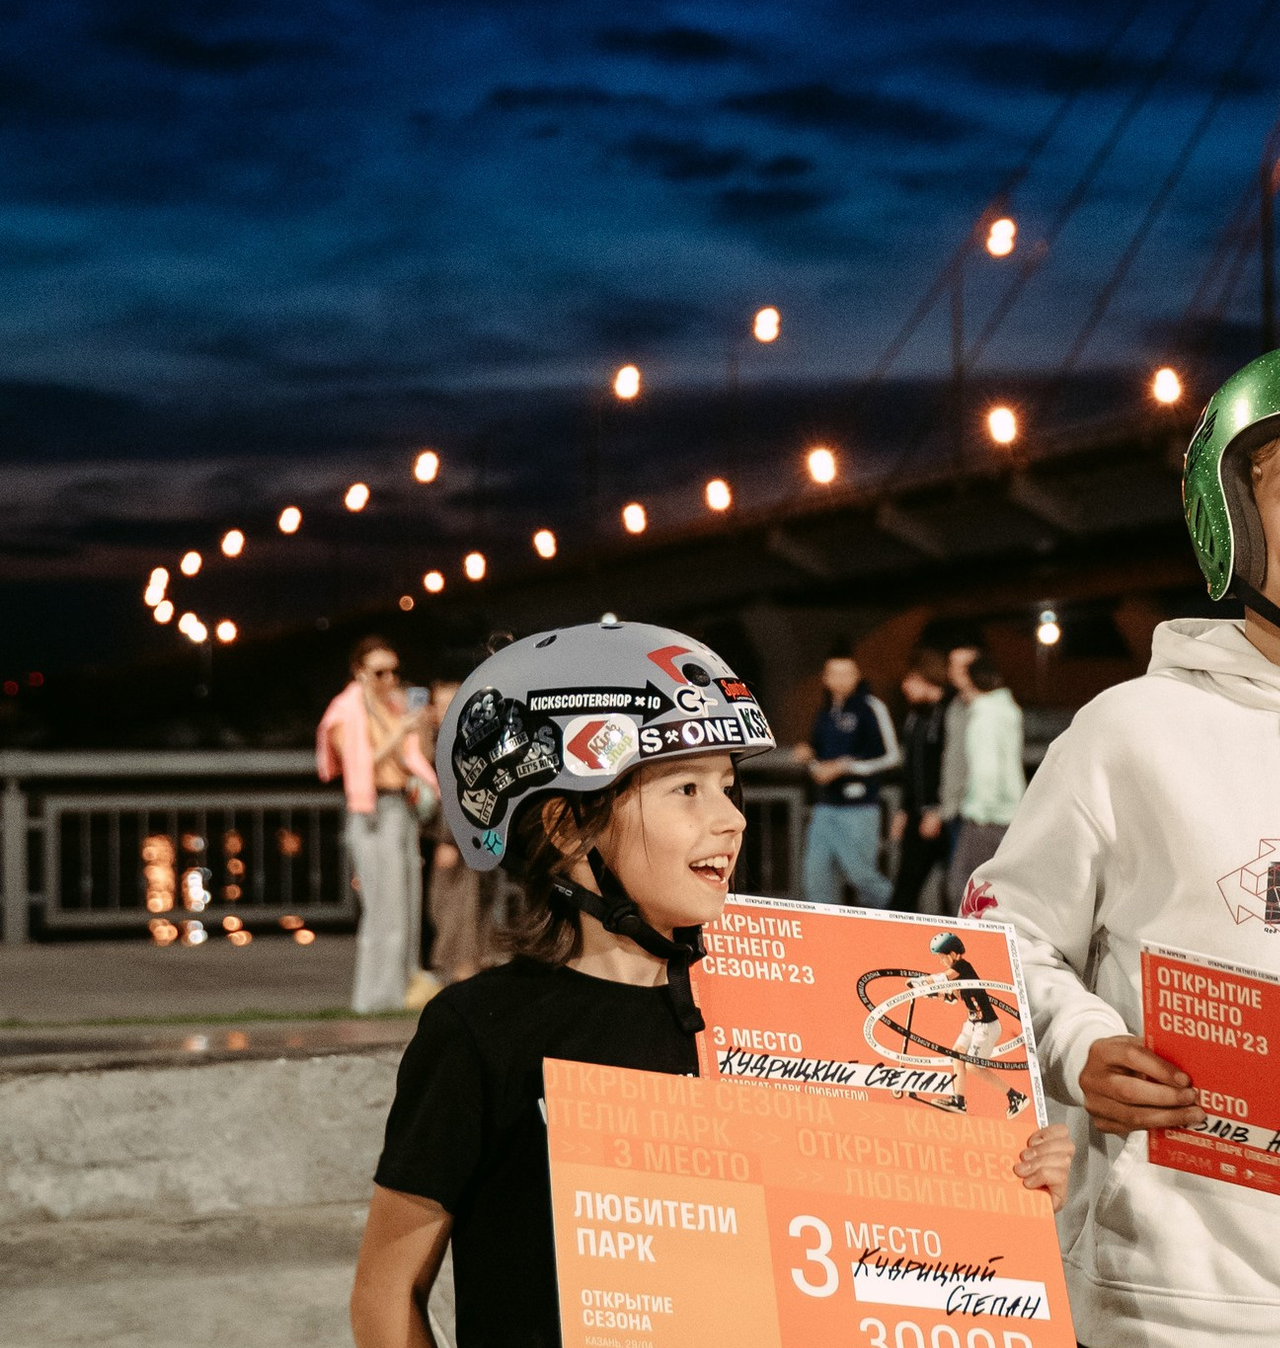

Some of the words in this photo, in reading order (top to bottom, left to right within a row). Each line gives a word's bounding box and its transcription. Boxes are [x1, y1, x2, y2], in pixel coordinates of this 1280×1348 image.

[530, 694, 632, 712] KICKSCOOTERSHOP
[681, 718, 742, 745] ONE
[518, 762, 540, 777] LET'S
[702, 956, 815, 985] СЕЗОНА'23
[1157, 966, 1262, 1010] ОТКРЫТИЕ
[1158, 989, 1243, 1027] ЛЕТНЕГО
[713, 1026, 726, 1046] 3
[732, 1029, 802, 1053] МЕСТО
[1159, 1011, 1269, 1056] СЕЗОНА'23
[715, 1084, 834, 1125] СЕЗОНА
[905, 1110, 1017, 1150] КАЗАНЬ
[1196, 1087, 1249, 1118] ЕСТО
[650, 1109, 734, 1148] ПАРК
[800, 1128, 956, 1175] ОТКРЫТИЕ
[613, 1138, 632, 1168] 3
[644, 1141, 750, 1182] МЕСТО
[846, 1168, 1010, 1213] ЛЮБИТЕЛИ
[574, 1190, 738, 1235] ЛЮБИТЕЛИ
[576, 1227, 657, 1263] ПАРК
[788, 1214, 840, 1298] 3
[844, 1220, 942, 1258] МЕСТО
[581, 1289, 674, 1314] ОТКРЫТИЕ
[583, 1309, 653, 1332] СЕЗОНА
